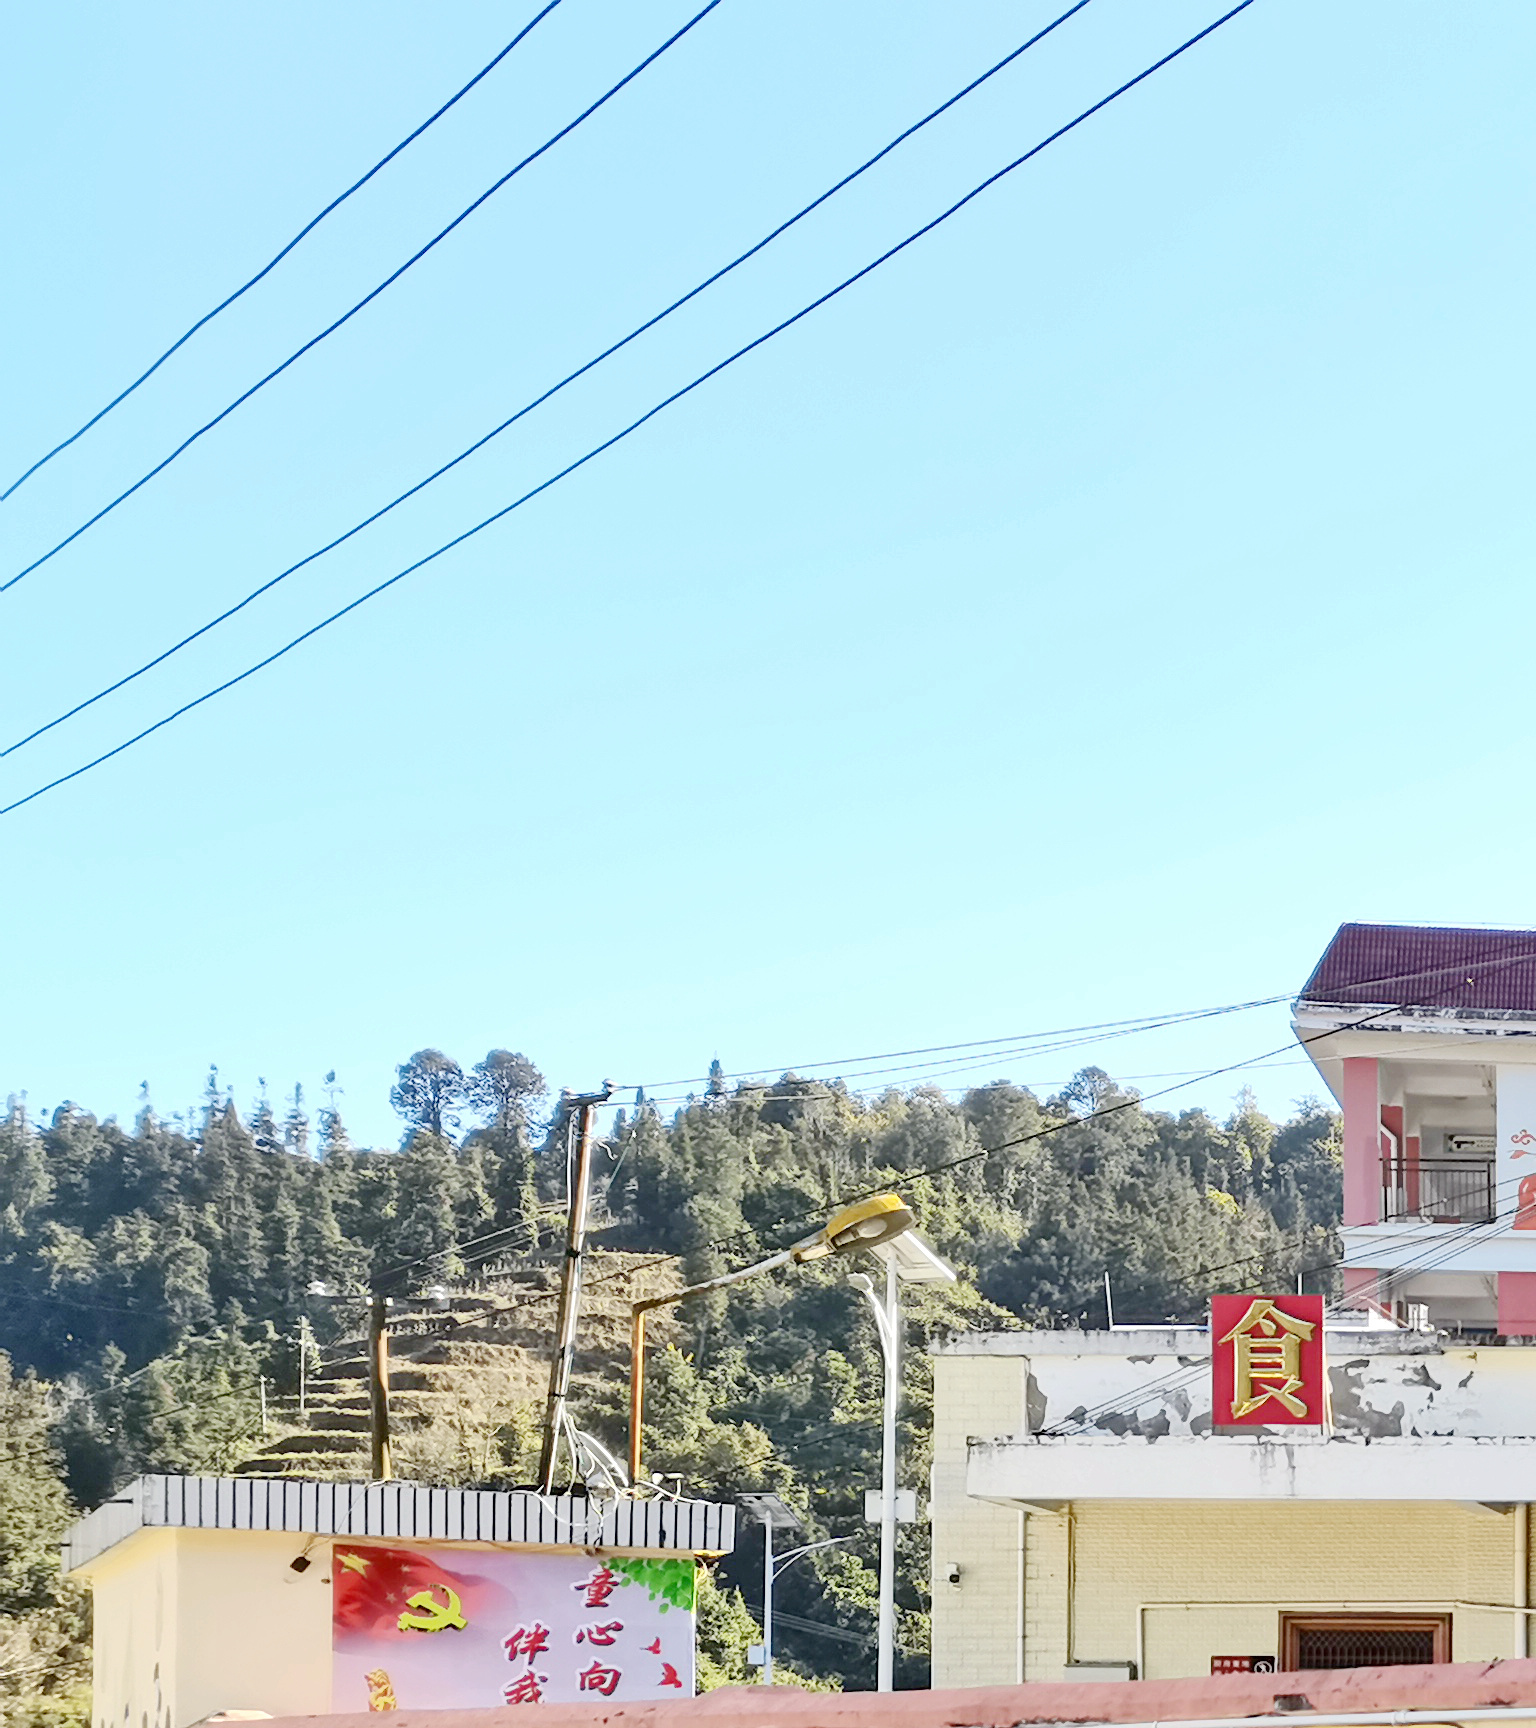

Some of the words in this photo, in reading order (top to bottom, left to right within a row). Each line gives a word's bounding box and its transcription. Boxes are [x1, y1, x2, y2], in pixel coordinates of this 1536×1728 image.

[1216, 1298, 1317, 1422] 食
[574, 1567, 624, 1697] 童心向
